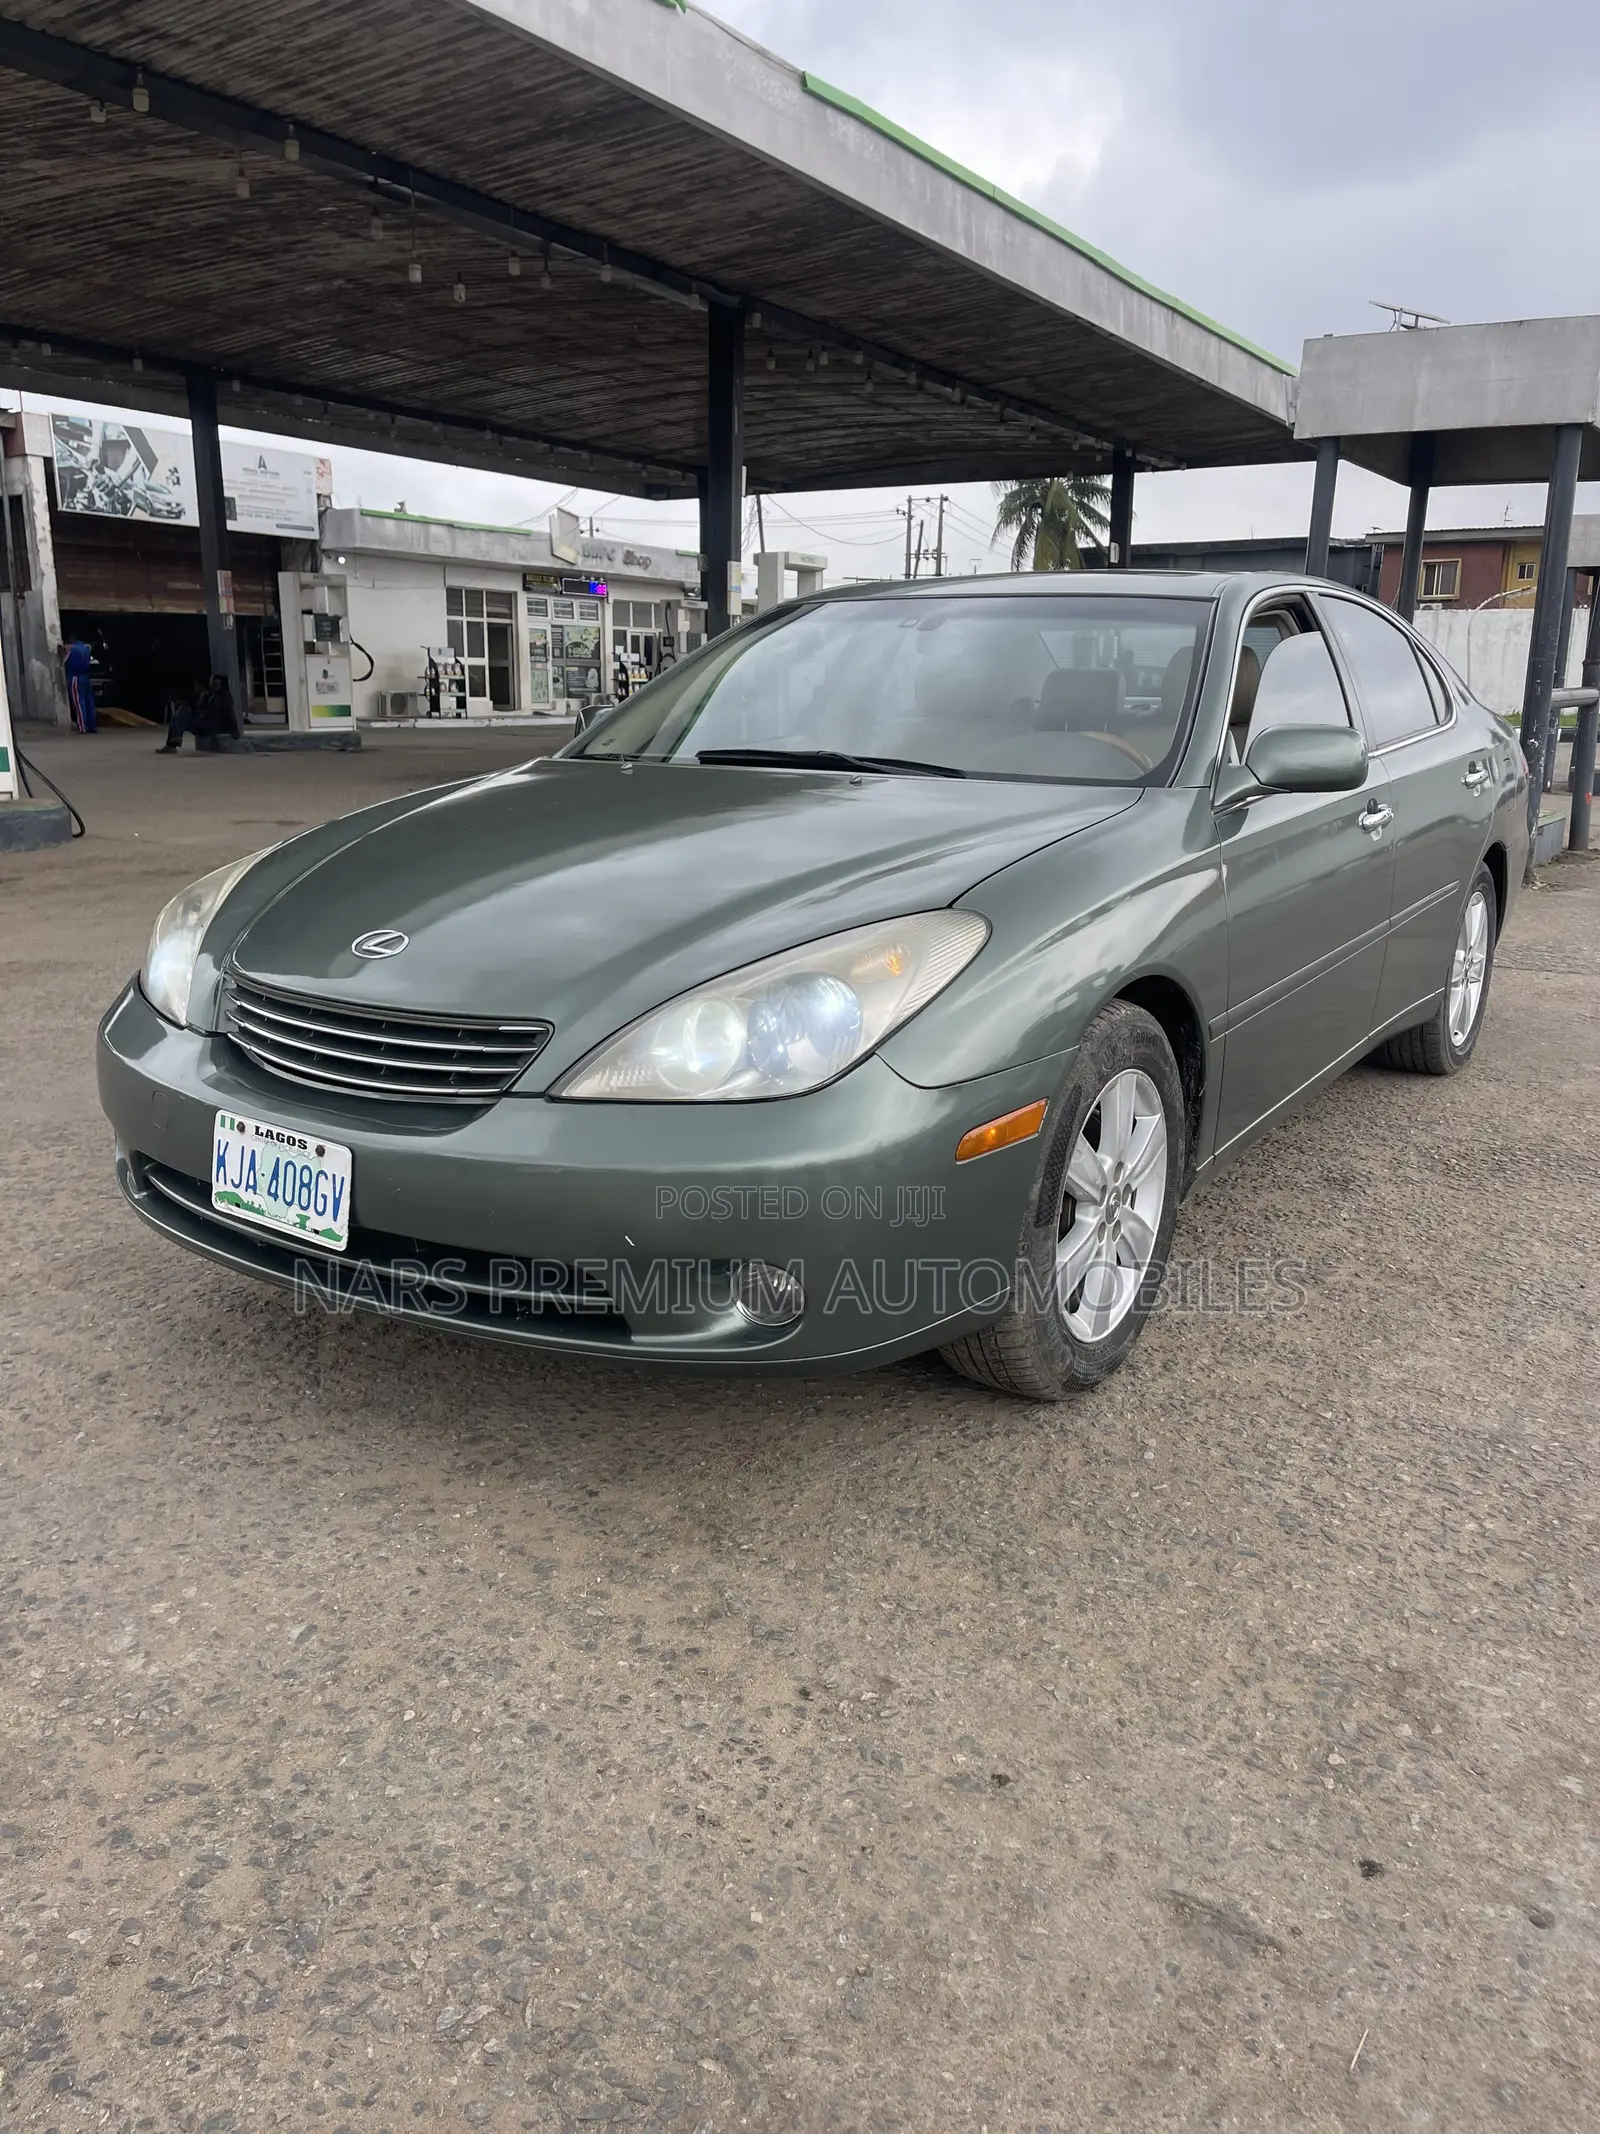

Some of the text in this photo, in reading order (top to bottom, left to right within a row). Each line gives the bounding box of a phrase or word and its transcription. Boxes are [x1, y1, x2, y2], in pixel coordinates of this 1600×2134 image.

[254, 1125, 308, 1150] LAGOS
[216, 1139, 345, 1222] KJA 408GV
